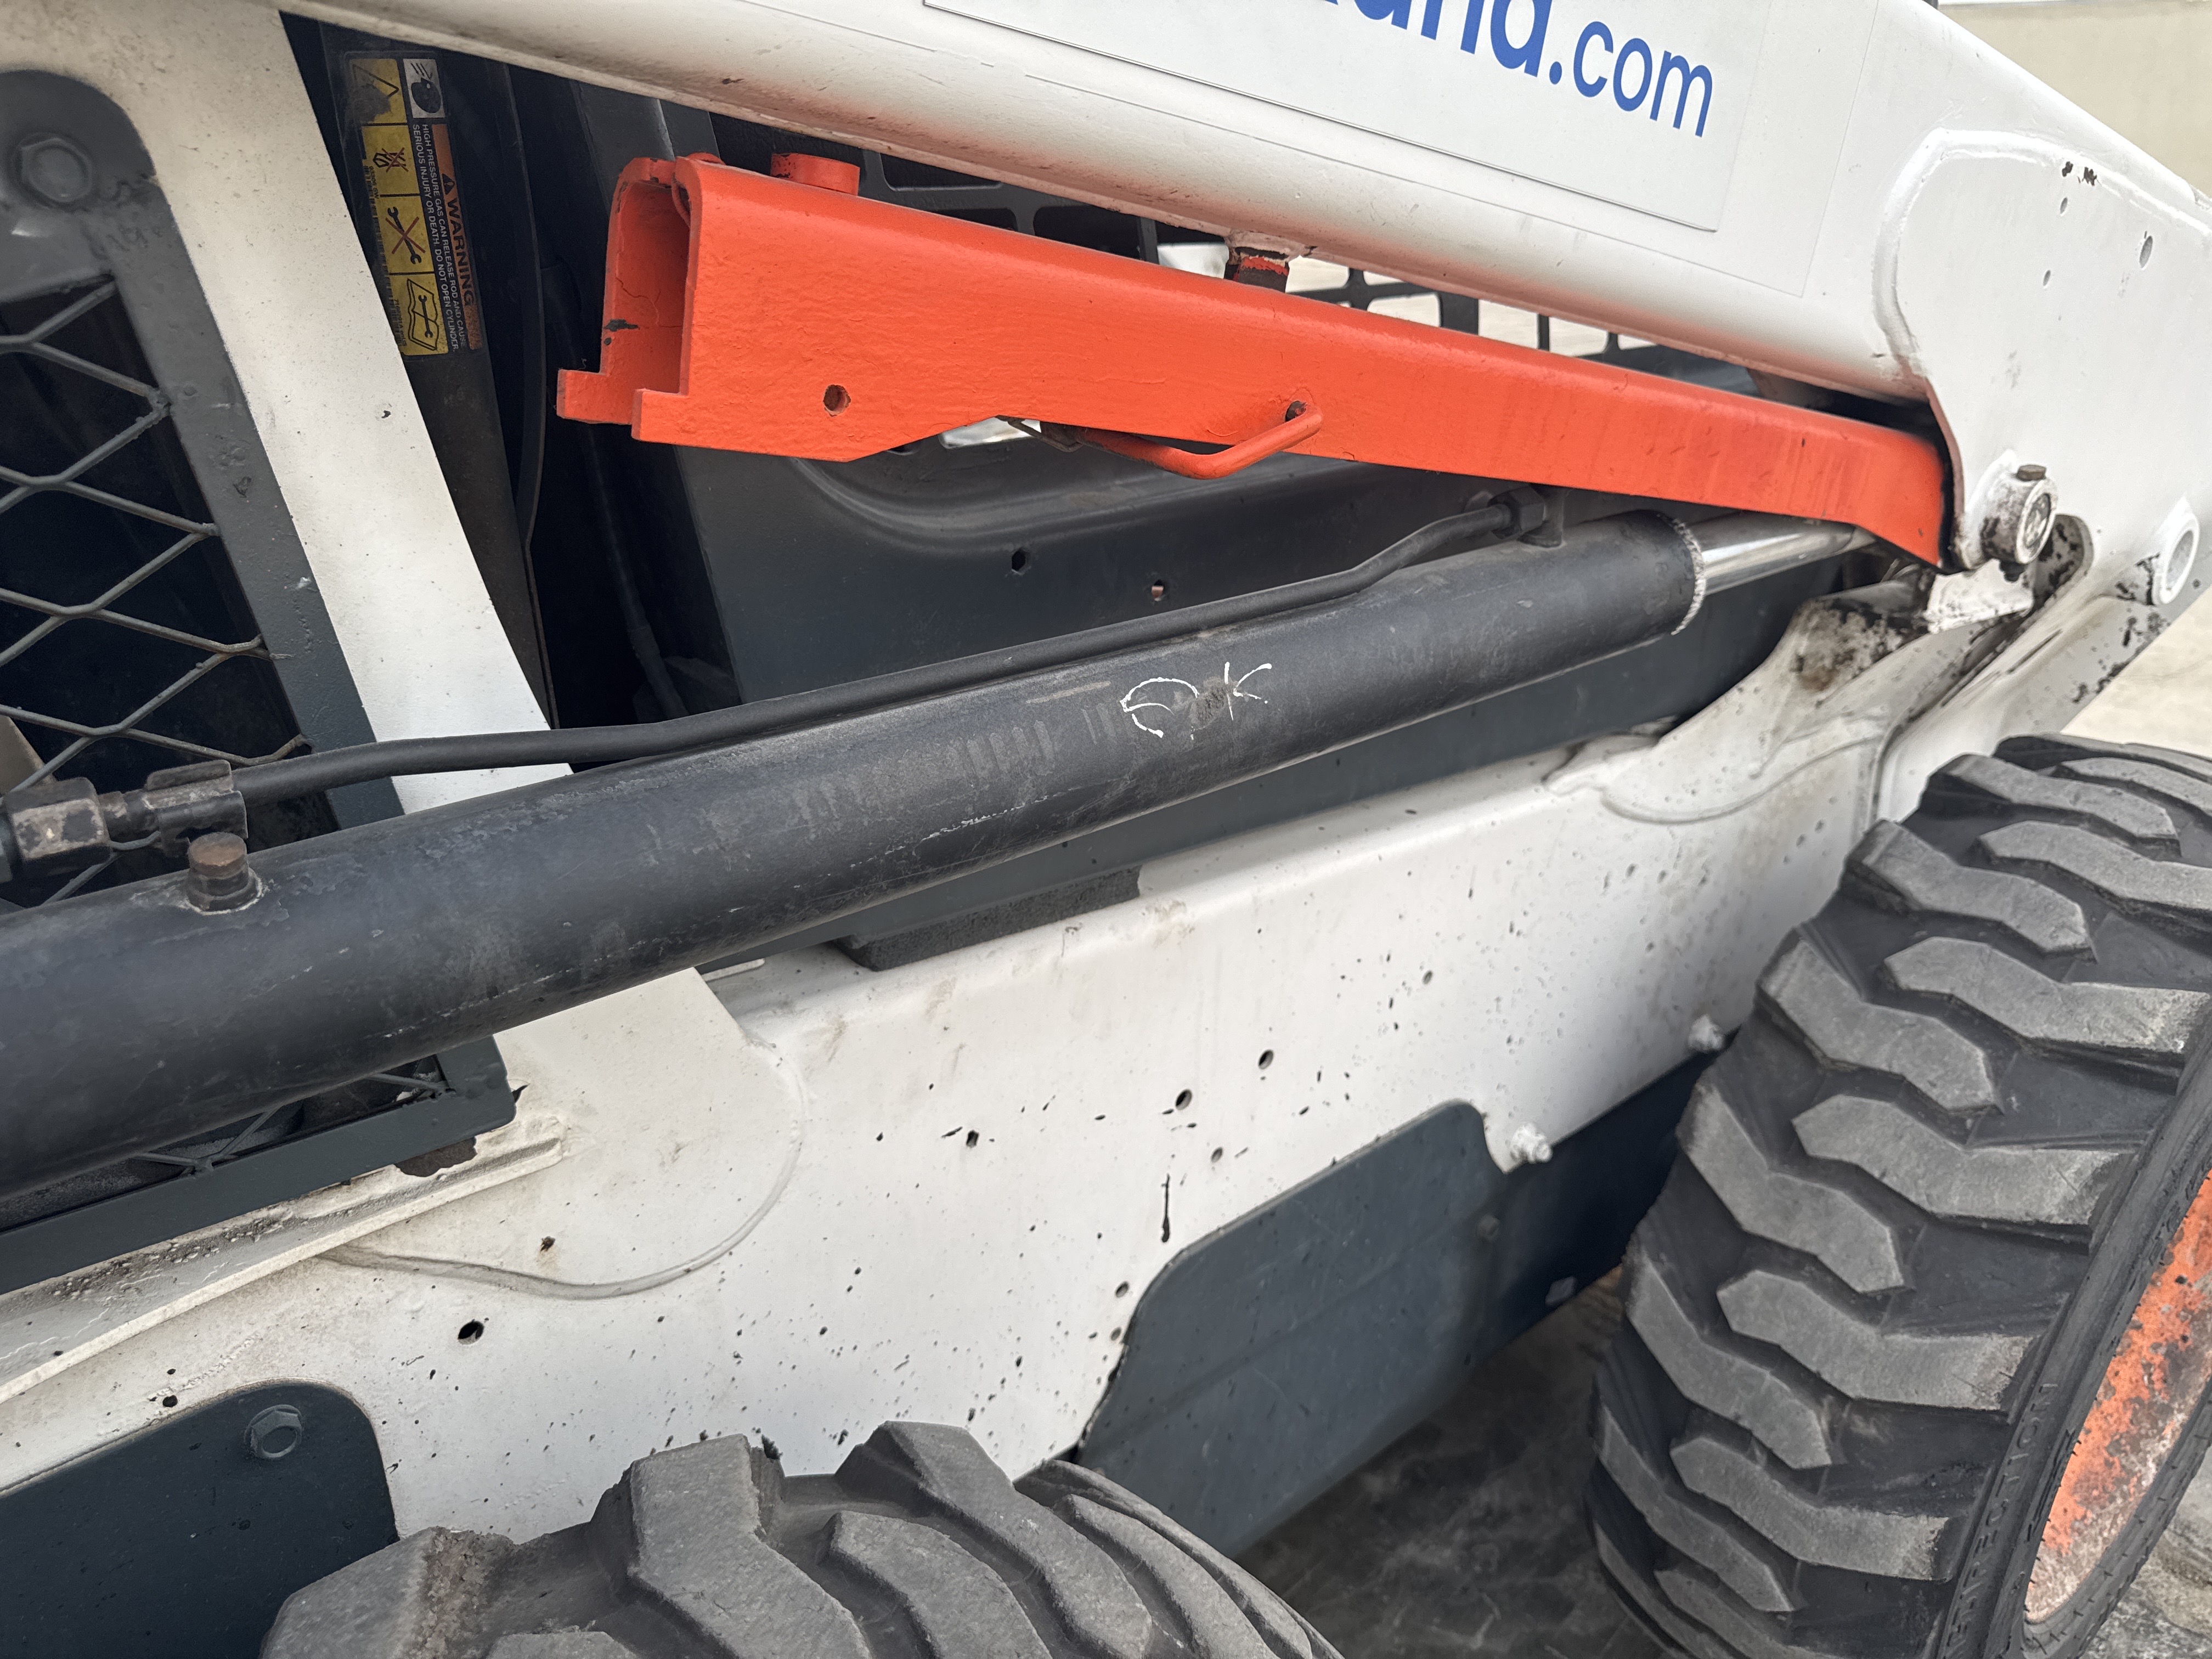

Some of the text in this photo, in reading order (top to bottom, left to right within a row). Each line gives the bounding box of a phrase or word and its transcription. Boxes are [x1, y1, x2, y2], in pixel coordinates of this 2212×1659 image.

[413, 125, 426, 163] SERIOUS
[420, 167, 432, 198] INJURY
[426, 200, 434, 213] OR
[422, 125, 432, 146] HIGH
[427, 149, 440, 196] PRESSURE
[435, 199, 443, 216] GAS
[439, 219, 447, 237] CAN
[443, 240, 454, 277] RELEASE
[453, 301, 461, 318] AND
[457, 320, 467, 346] CAUSE
[435, 249, 444, 262] DO
[448, 198, 475, 306] WARNING
[437, 264, 447, 281] NOT
[441, 284, 450, 307] OPEN
